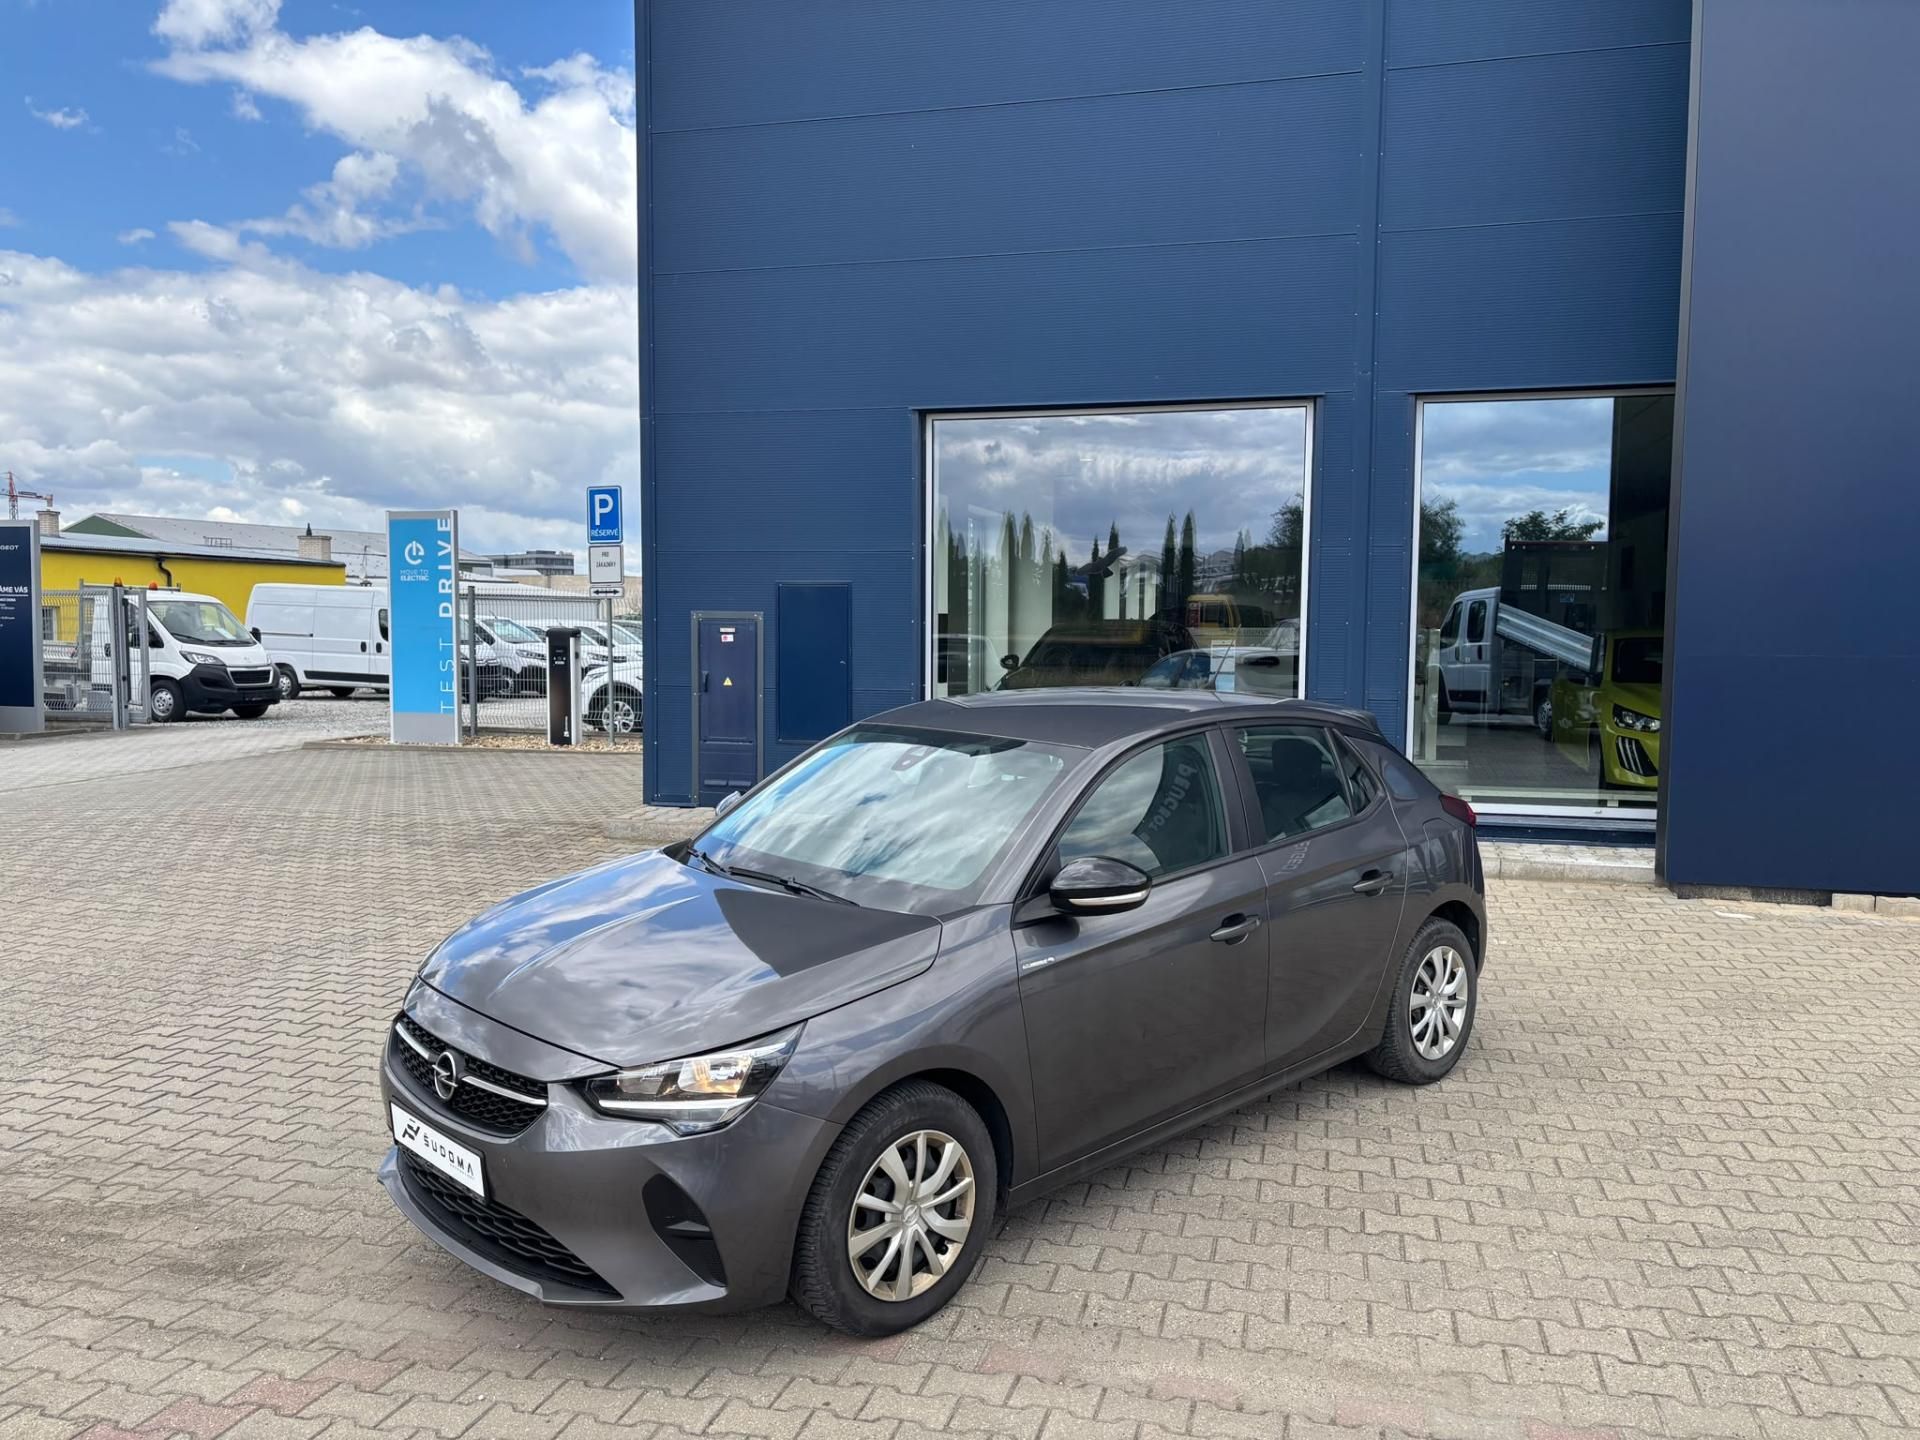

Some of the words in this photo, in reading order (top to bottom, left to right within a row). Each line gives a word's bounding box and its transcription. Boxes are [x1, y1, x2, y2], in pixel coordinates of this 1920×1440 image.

[591, 528, 618, 536] RÉSERVÉ
[594, 494, 614, 525] P
[437, 518, 454, 618] DRIVE
[439, 639, 455, 714] TEST
